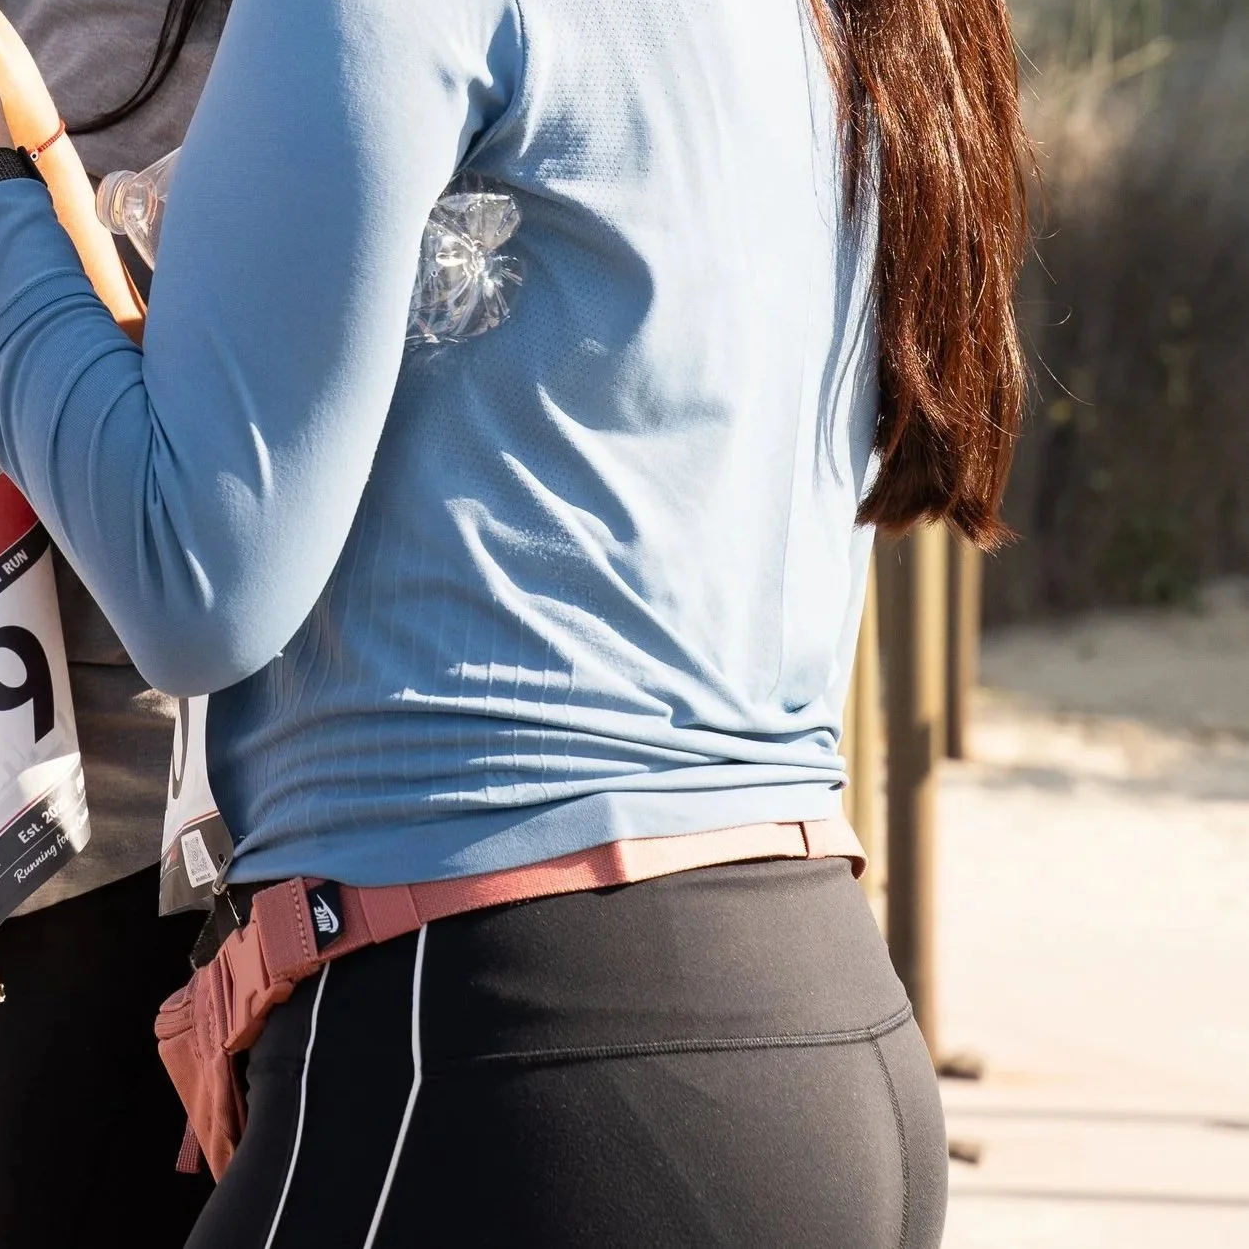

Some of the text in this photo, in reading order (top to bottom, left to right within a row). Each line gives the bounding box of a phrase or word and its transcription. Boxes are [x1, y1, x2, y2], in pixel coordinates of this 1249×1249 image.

[1, 549, 29, 575] RUN
[17, 822, 44, 845] Est.
[13, 844, 58, 884] Running
[313, 905, 332, 932] NIKE
